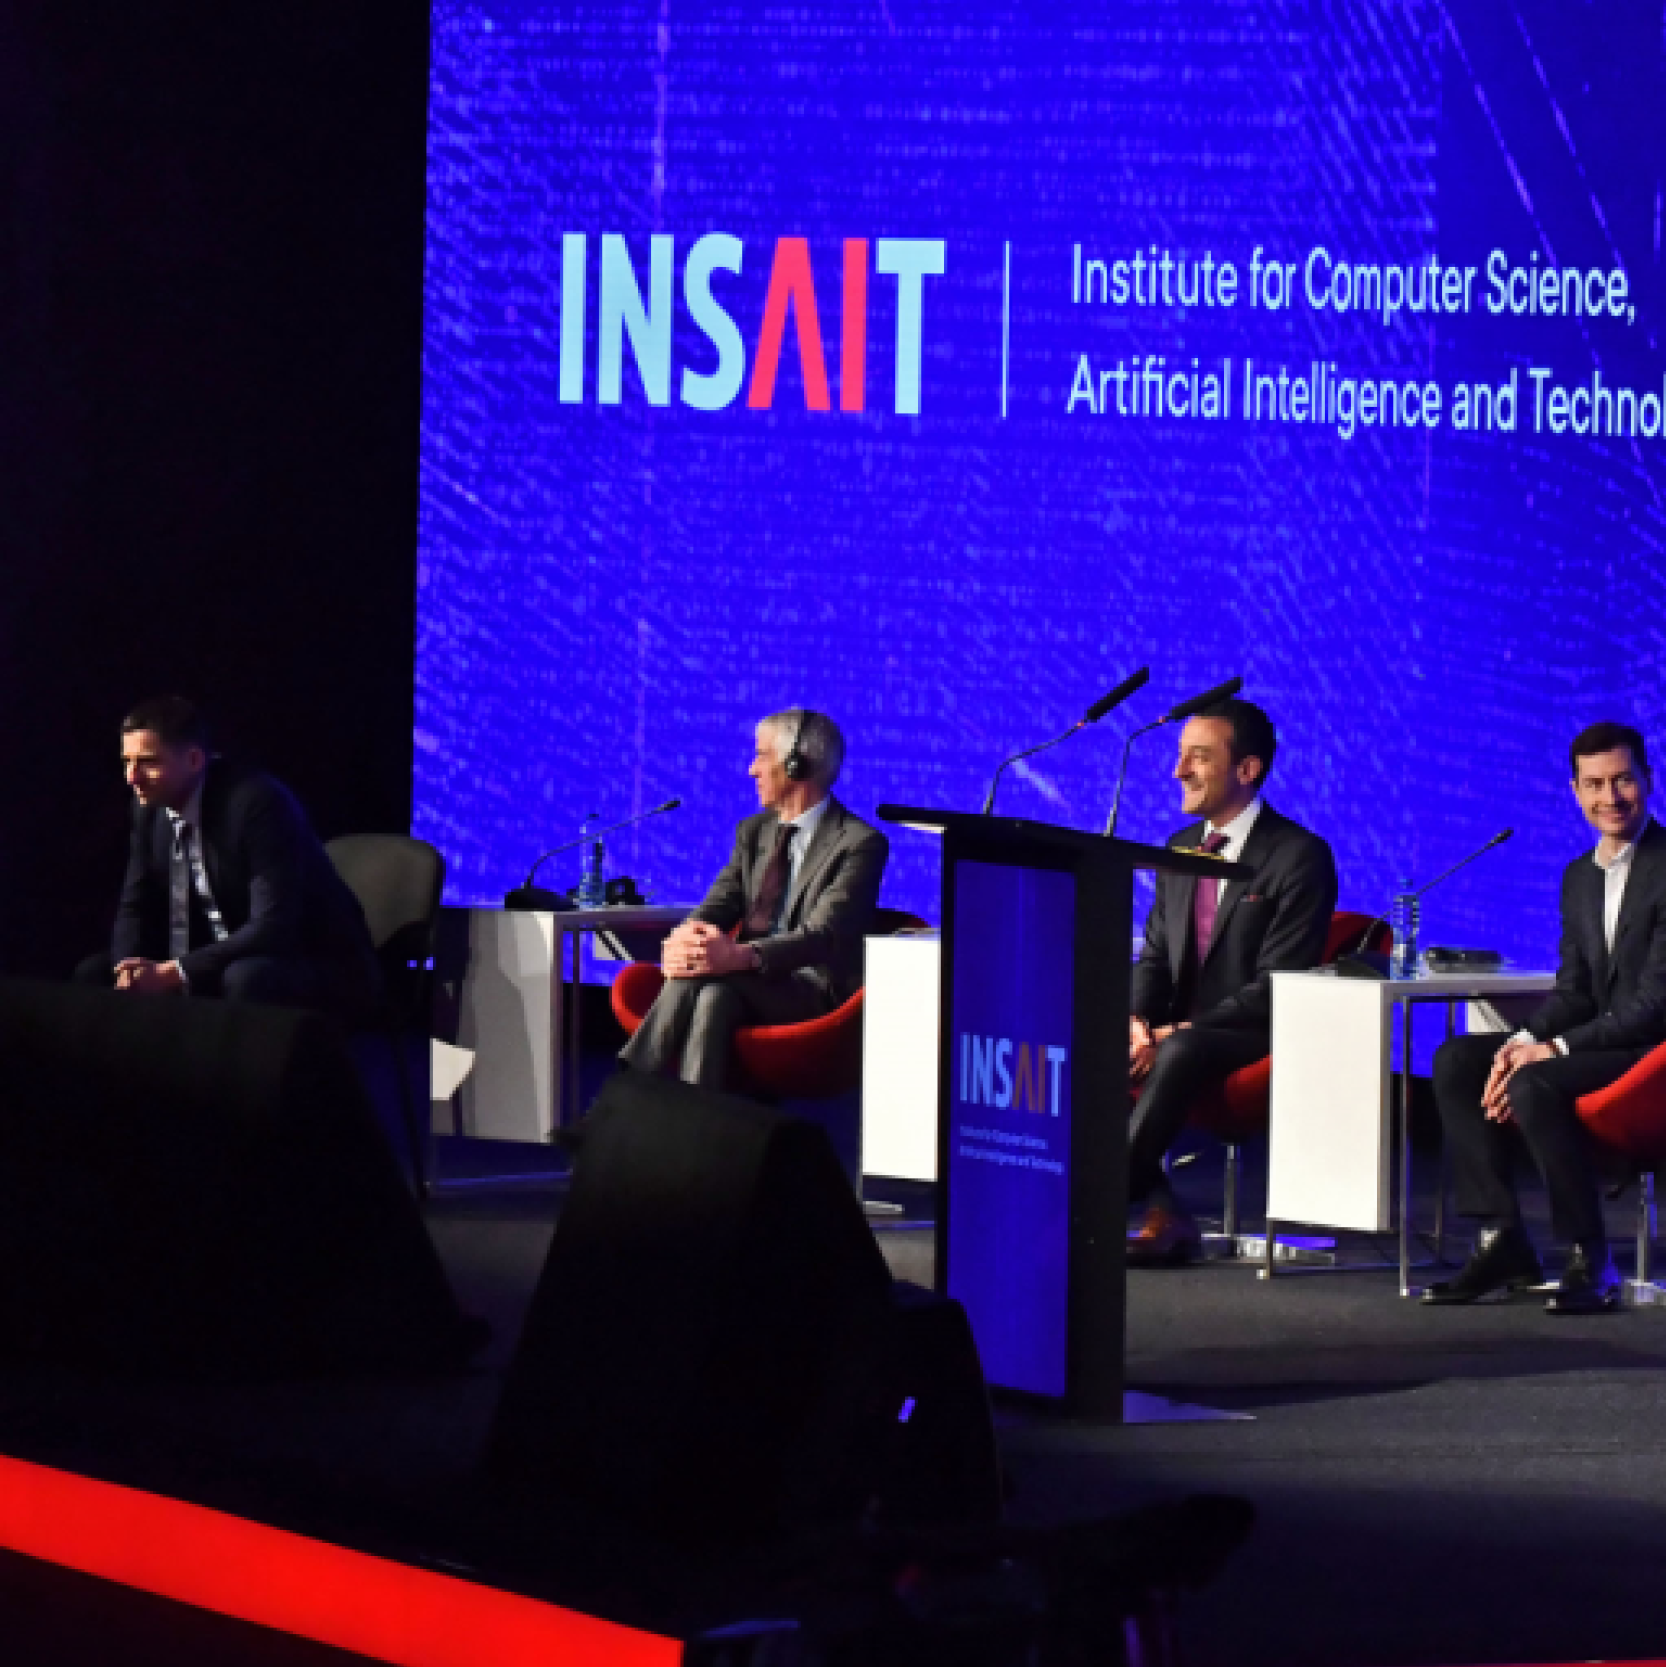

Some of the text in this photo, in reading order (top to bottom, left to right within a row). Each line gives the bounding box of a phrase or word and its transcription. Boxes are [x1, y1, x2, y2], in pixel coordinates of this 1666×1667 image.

[558, 231, 946, 415] INSAIT
[1072, 241, 1636, 327] Institute for Computer Science,
[1064, 353, 1232, 418] Artificial
[1242, 357, 1443, 441] Intelligence
[1450, 366, 1519, 432] and
[959, 1031, 1068, 1118] INSAIT
